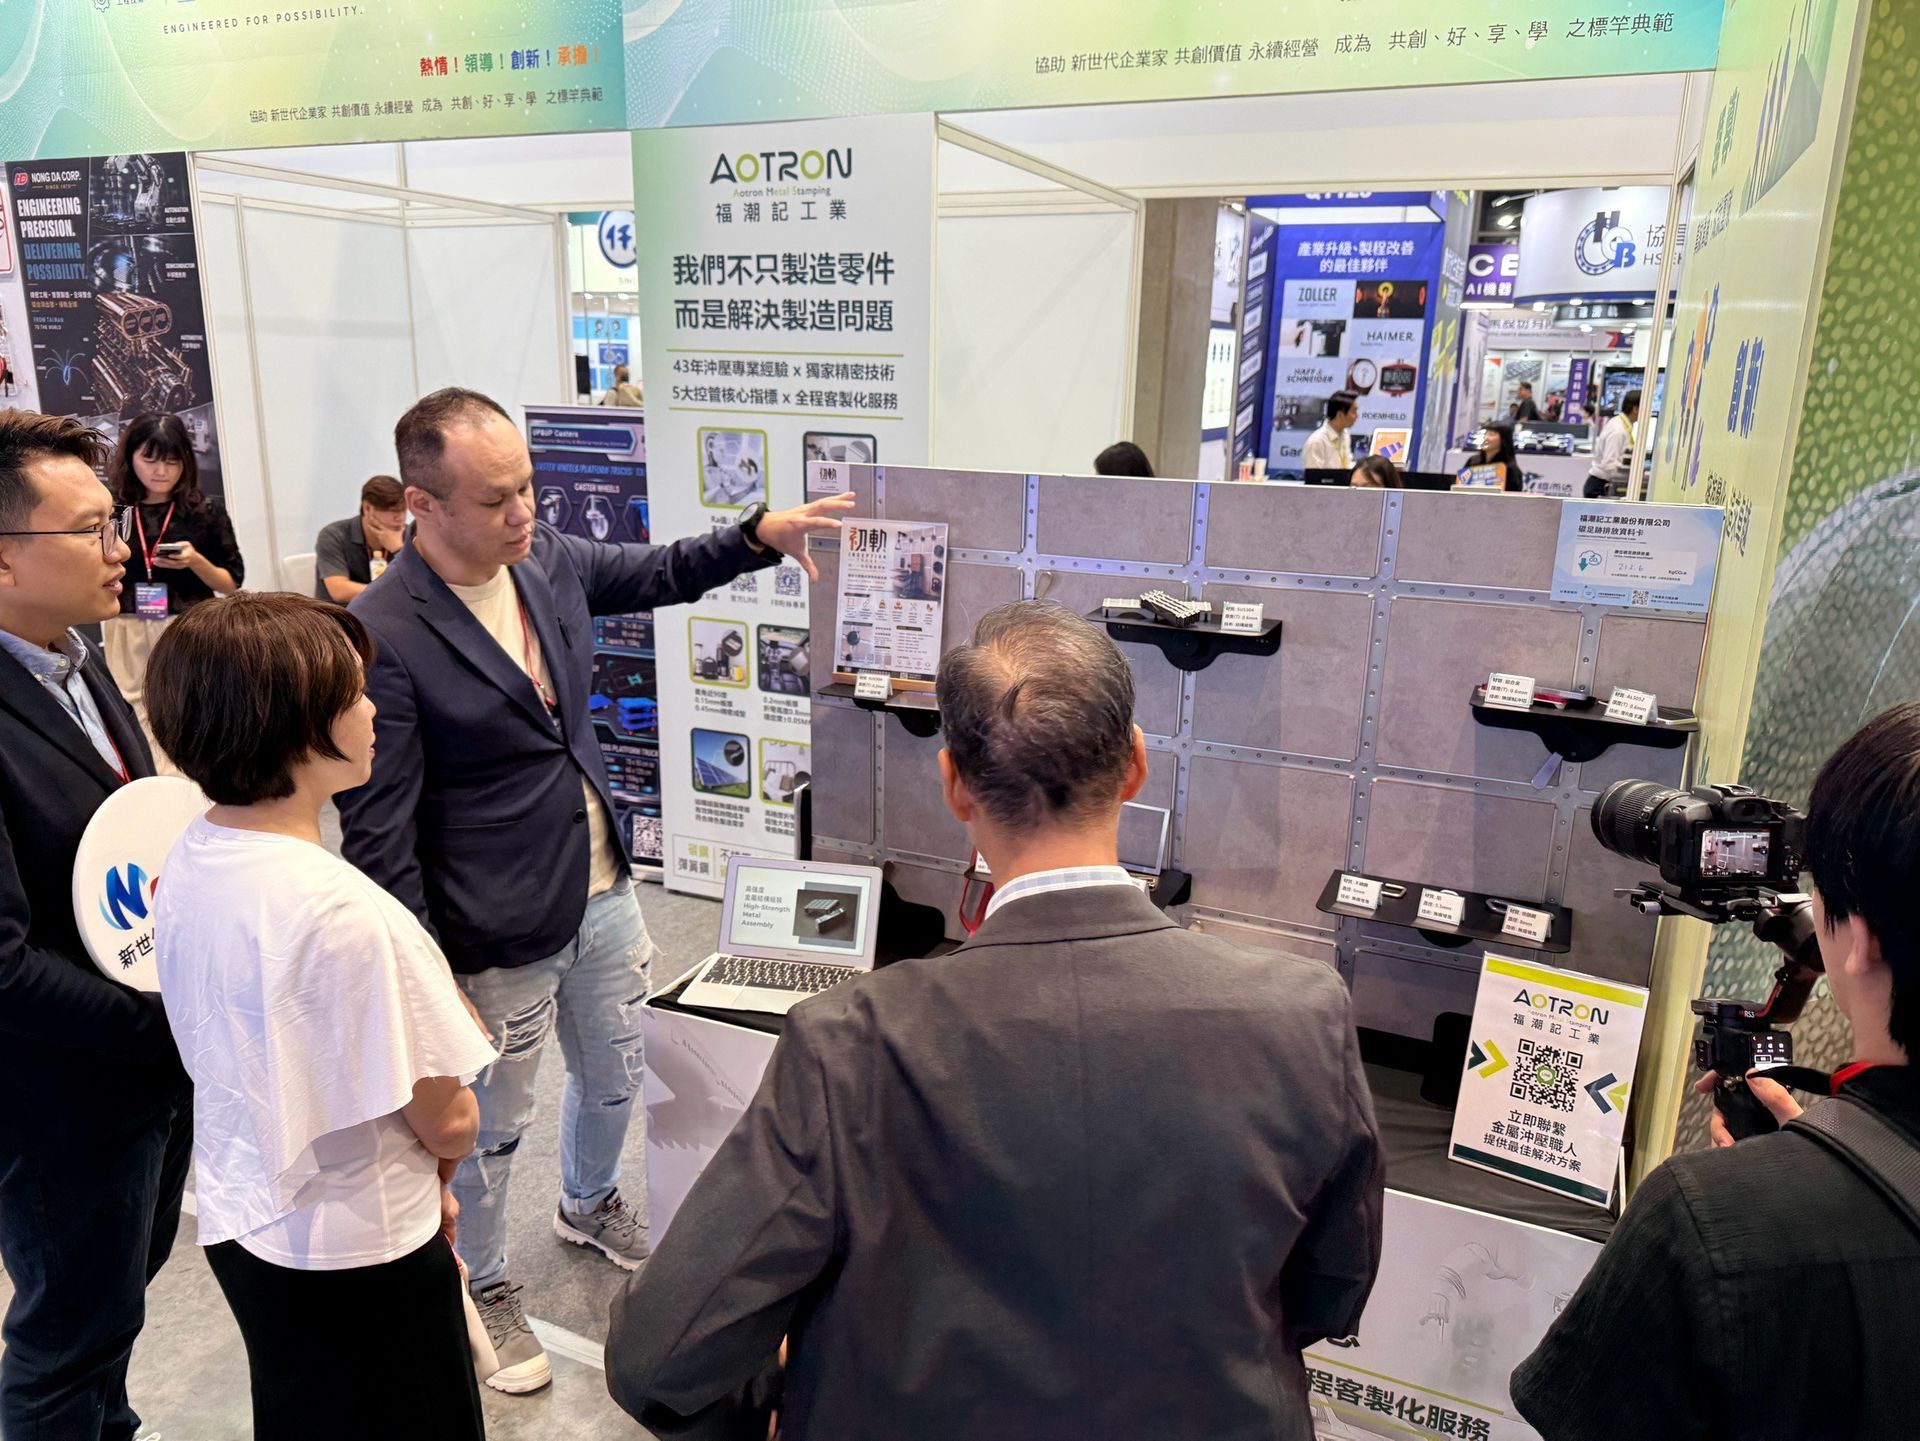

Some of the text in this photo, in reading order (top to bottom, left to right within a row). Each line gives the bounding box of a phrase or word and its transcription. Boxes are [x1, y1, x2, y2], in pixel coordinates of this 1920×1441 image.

[163, 5, 364, 35] ENGINEERED FOR POSSIBILITY.
[1035, 56, 1066, 74] 協助
[1071, 48, 1169, 72] 新世代企業家
[1174, 43, 1243, 66] 共創價值
[1247, 37, 1319, 61] 永續經營
[1334, 33, 1372, 55] 成為
[1566, 11, 1675, 40] 之標竿典範
[709, 147, 853, 185] AOTRON
[31, 172, 50, 183] NONG
[51, 171, 61, 182] DA
[733, 185, 831, 197] Aotron Metal Stamping
[17, 197, 82, 217] ENGINEERING
[715, 199, 848, 224] 福潮記工業
[20, 219, 76, 238] PRECISION.
[24, 242, 82, 260] DELIVERING
[1297, 240, 1415, 257] 產業升級、製程改善
[27, 263, 88, 280] POSSIBILITY.
[673, 251, 895, 286] 我們不只製造零件
[1319, 258, 1389, 273] 的最佳夥伴
[1298, 287, 1338, 302] ZOLLER
[674, 298, 894, 332] 而是解決製造問題
[672, 359, 789, 378] 43年沖壓專業經驗
[806, 362, 895, 382] 獨家精密技術
[1286, 375, 1334, 384] SCHNEIDER
[672, 385, 778, 406] 5大控管核心指標
[795, 389, 898, 410] 全程客製化服務
[1361, 411, 1407, 421] ROEMHELD
[1579, 514, 1671, 528] 福潮記工業股份有限公司
[743, 902, 791, 913] High-Strength
[741, 919, 774, 929] Assembly
[117, 927, 155, 970] 新世
[1512, 988, 1610, 1026] AOTRON
[1513, 1013, 1601, 1045] 福潮記工業
[1507, 1109, 1567, 1137] 立即聯繫
[1491, 1120, 1578, 1158] 金屬沖壓職人
[1483, 1133, 1582, 1173] 提供最佳解決方案
